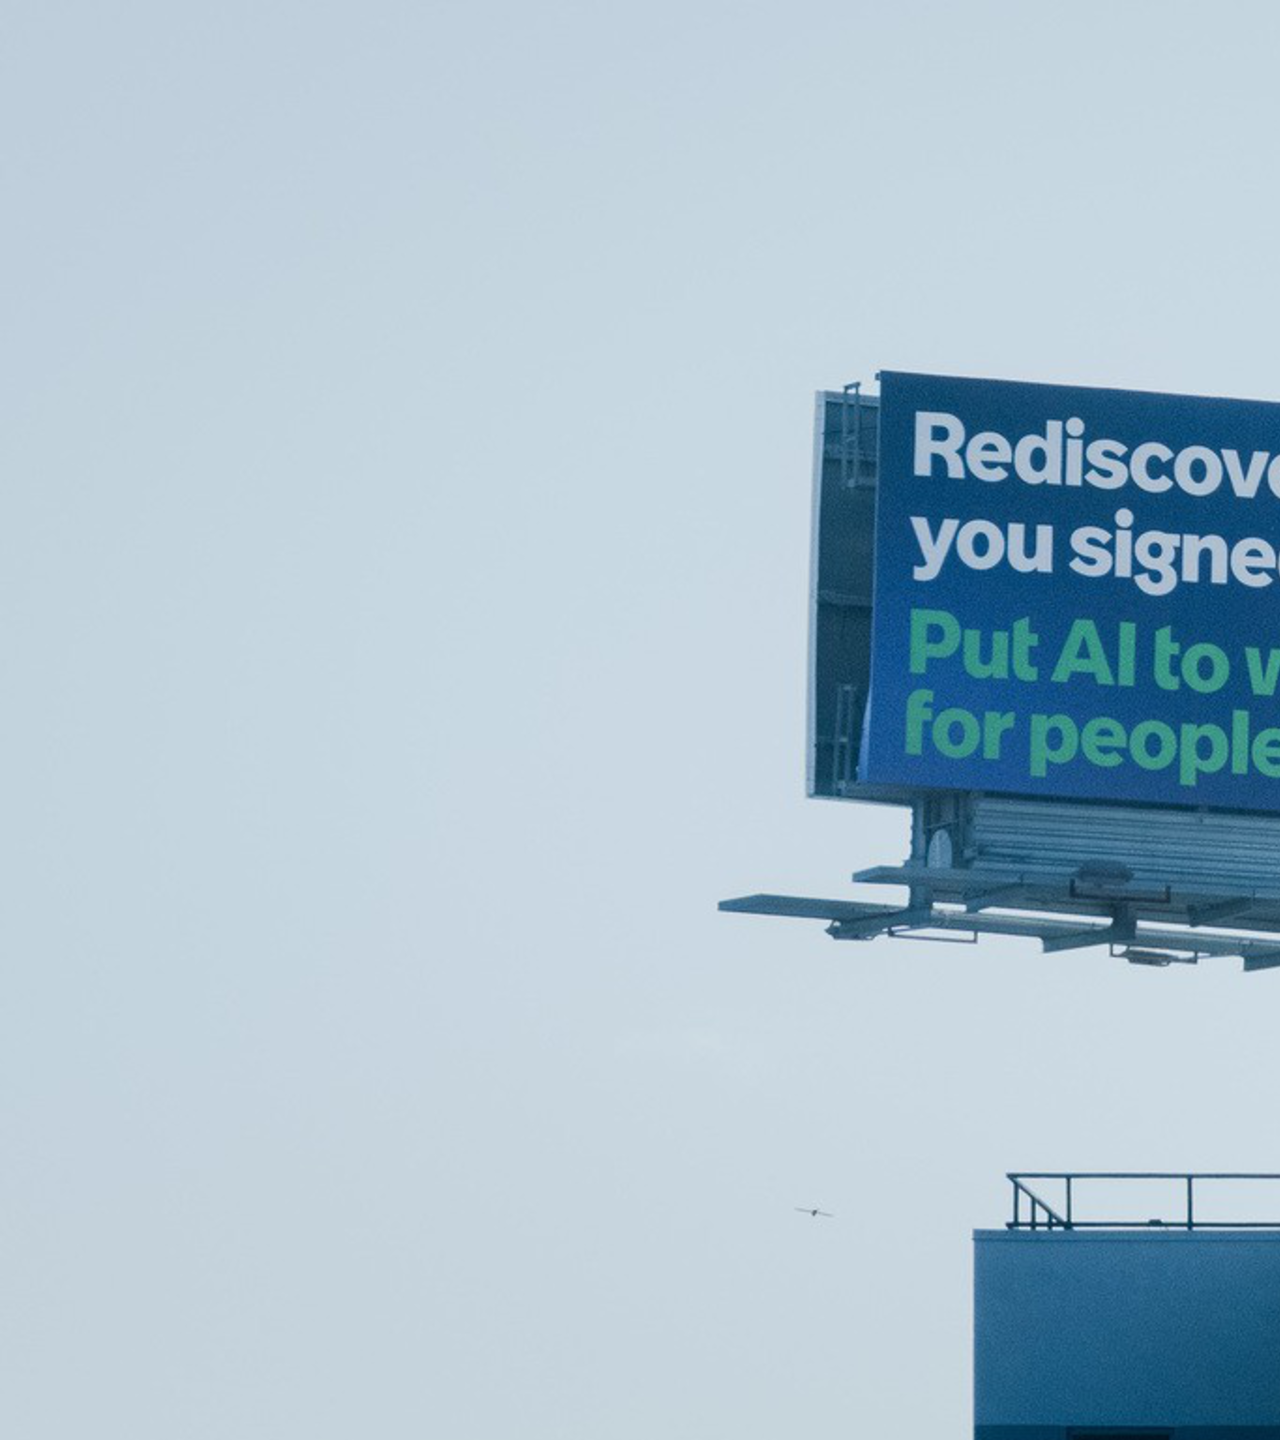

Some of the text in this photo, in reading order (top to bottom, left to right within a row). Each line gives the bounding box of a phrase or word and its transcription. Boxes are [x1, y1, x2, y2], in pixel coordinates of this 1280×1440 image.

[910, 515, 1054, 581] you
[908, 607, 1040, 682] Put
[1050, 617, 1138, 688] AI
[1153, 624, 1231, 695] to
[904, 688, 1016, 760] for
